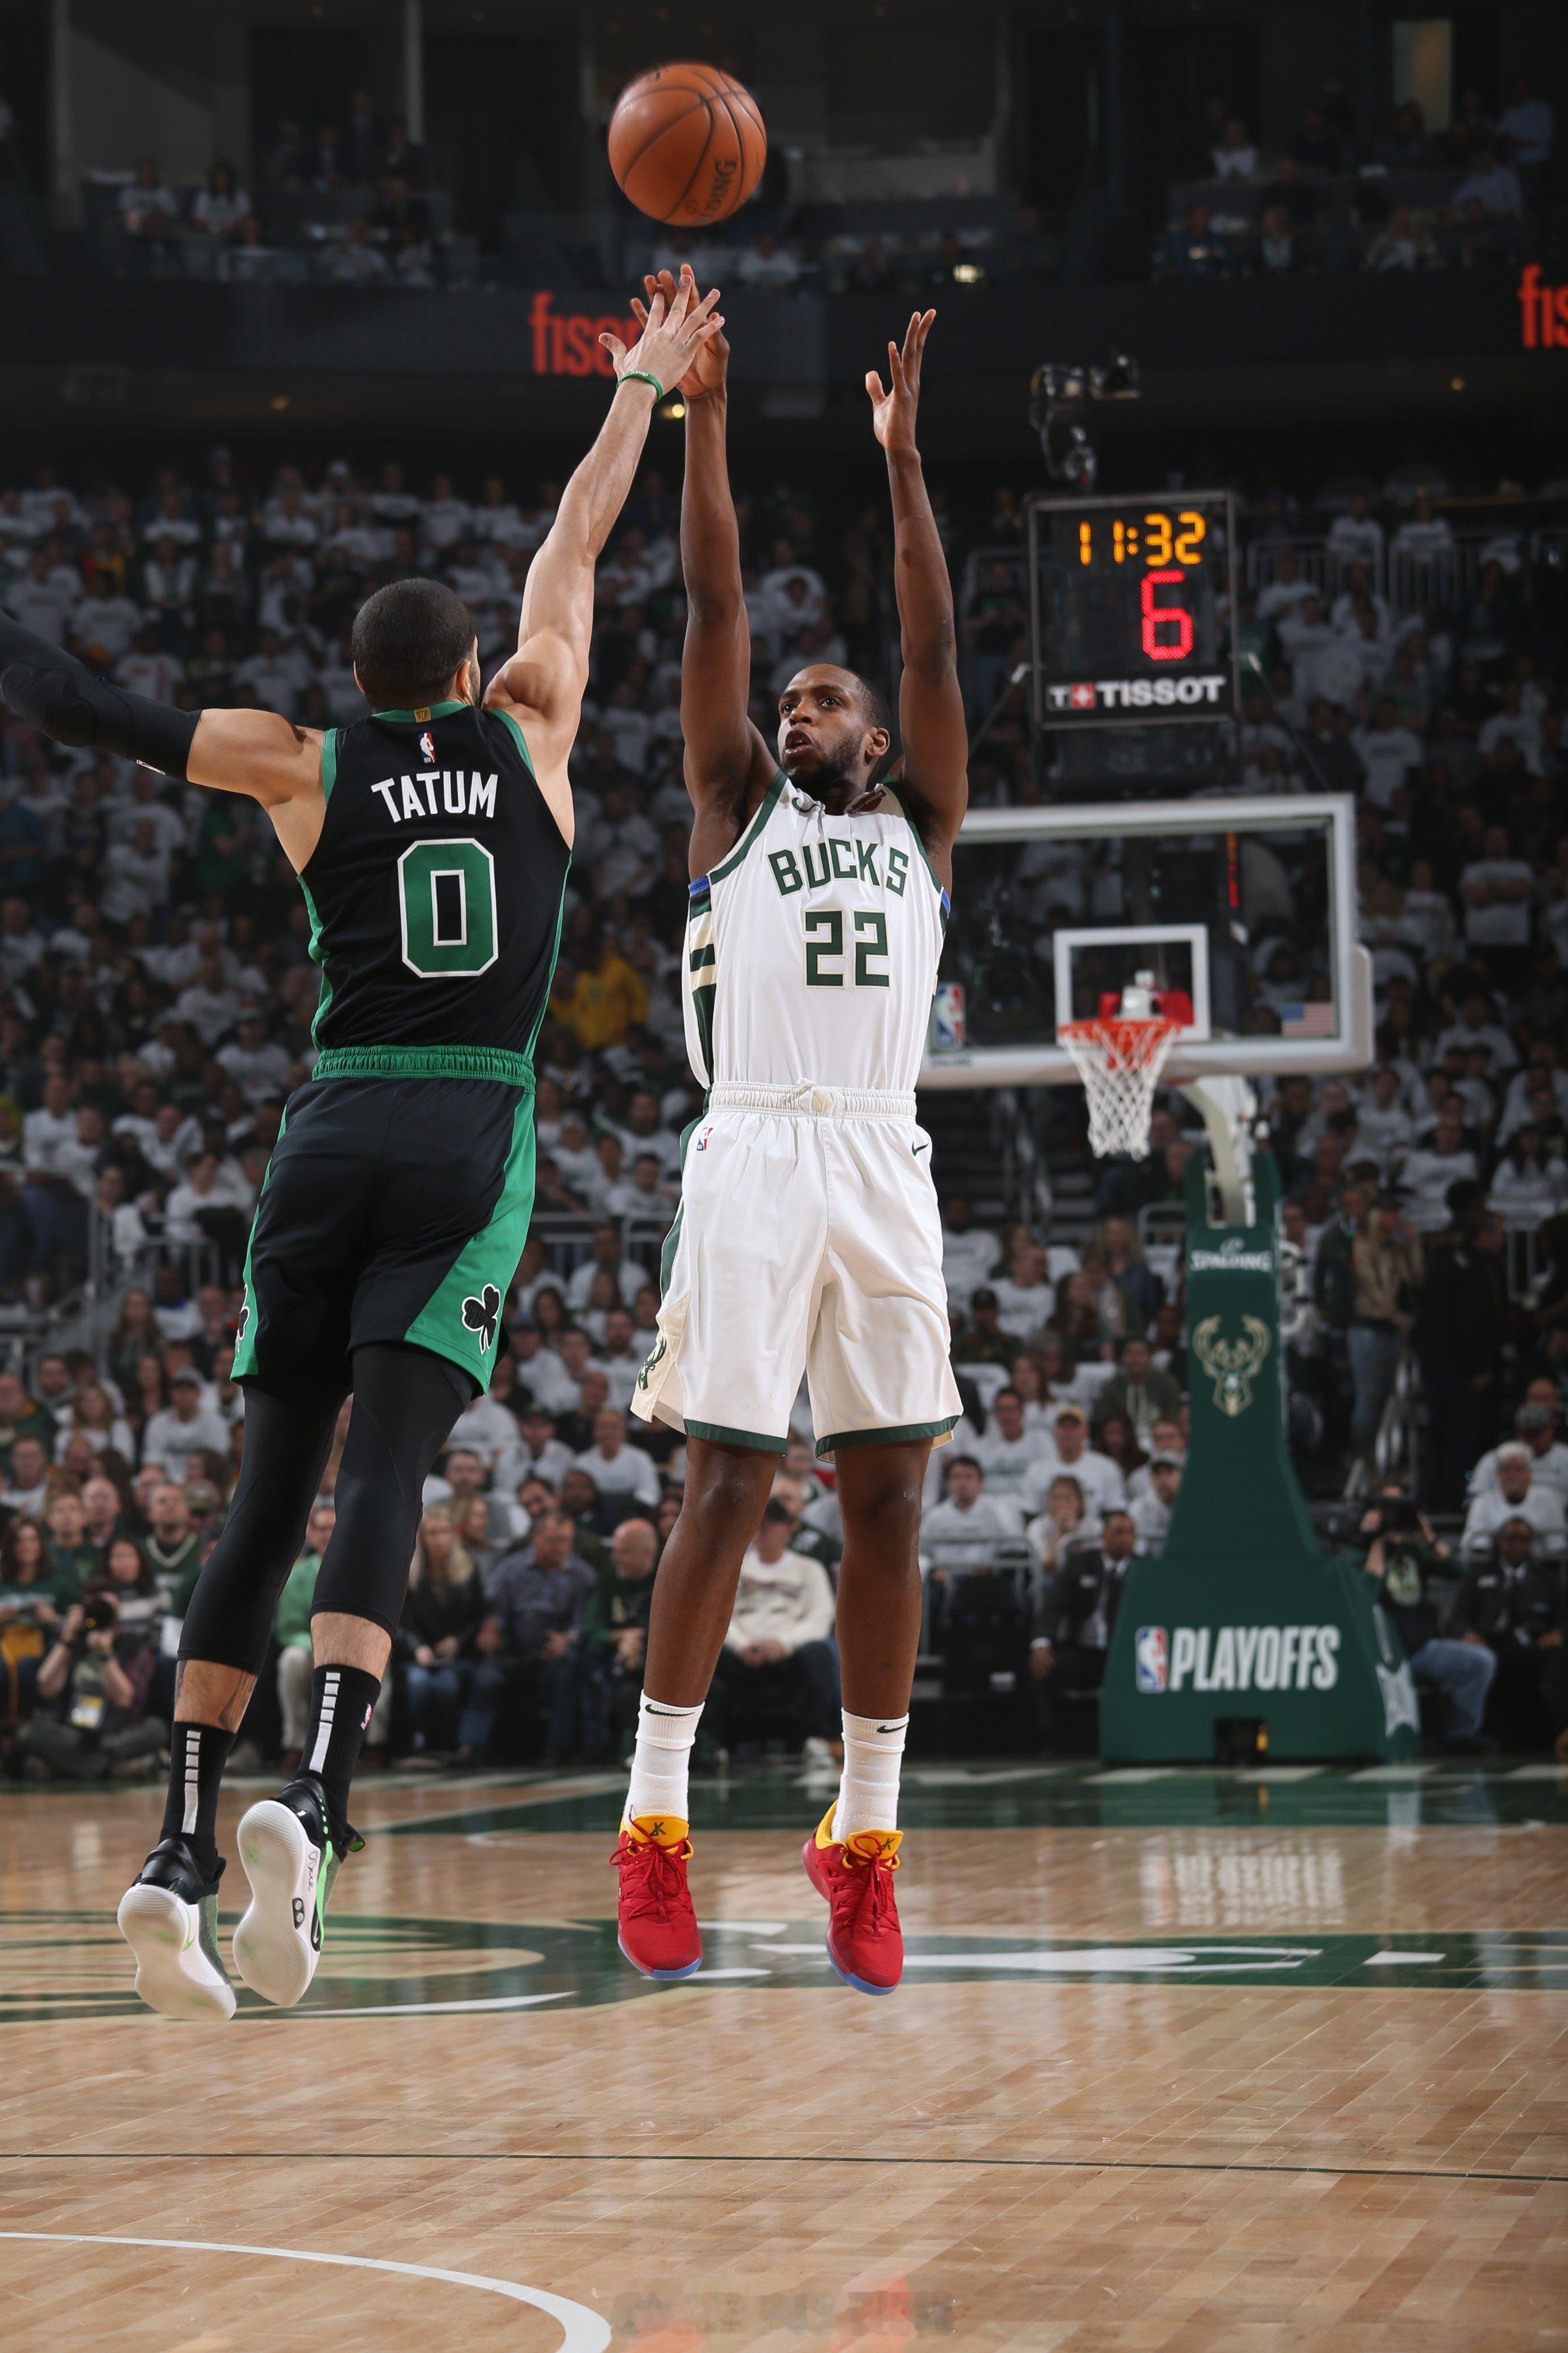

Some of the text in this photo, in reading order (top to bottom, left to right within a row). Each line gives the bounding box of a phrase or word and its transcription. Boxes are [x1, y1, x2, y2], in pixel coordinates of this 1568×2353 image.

[1079, 511, 1206, 566] 11:32
[1141, 569, 1194, 661] 6
[1095, 674, 1226, 708] TISSOT
[370, 770, 499, 823] TATUM
[766, 837, 909, 900] BUCKS
[397, 838, 499, 978] 0
[803, 908, 892, 988] 22
[1169, 1625, 1341, 1692] PLAYOFFS
